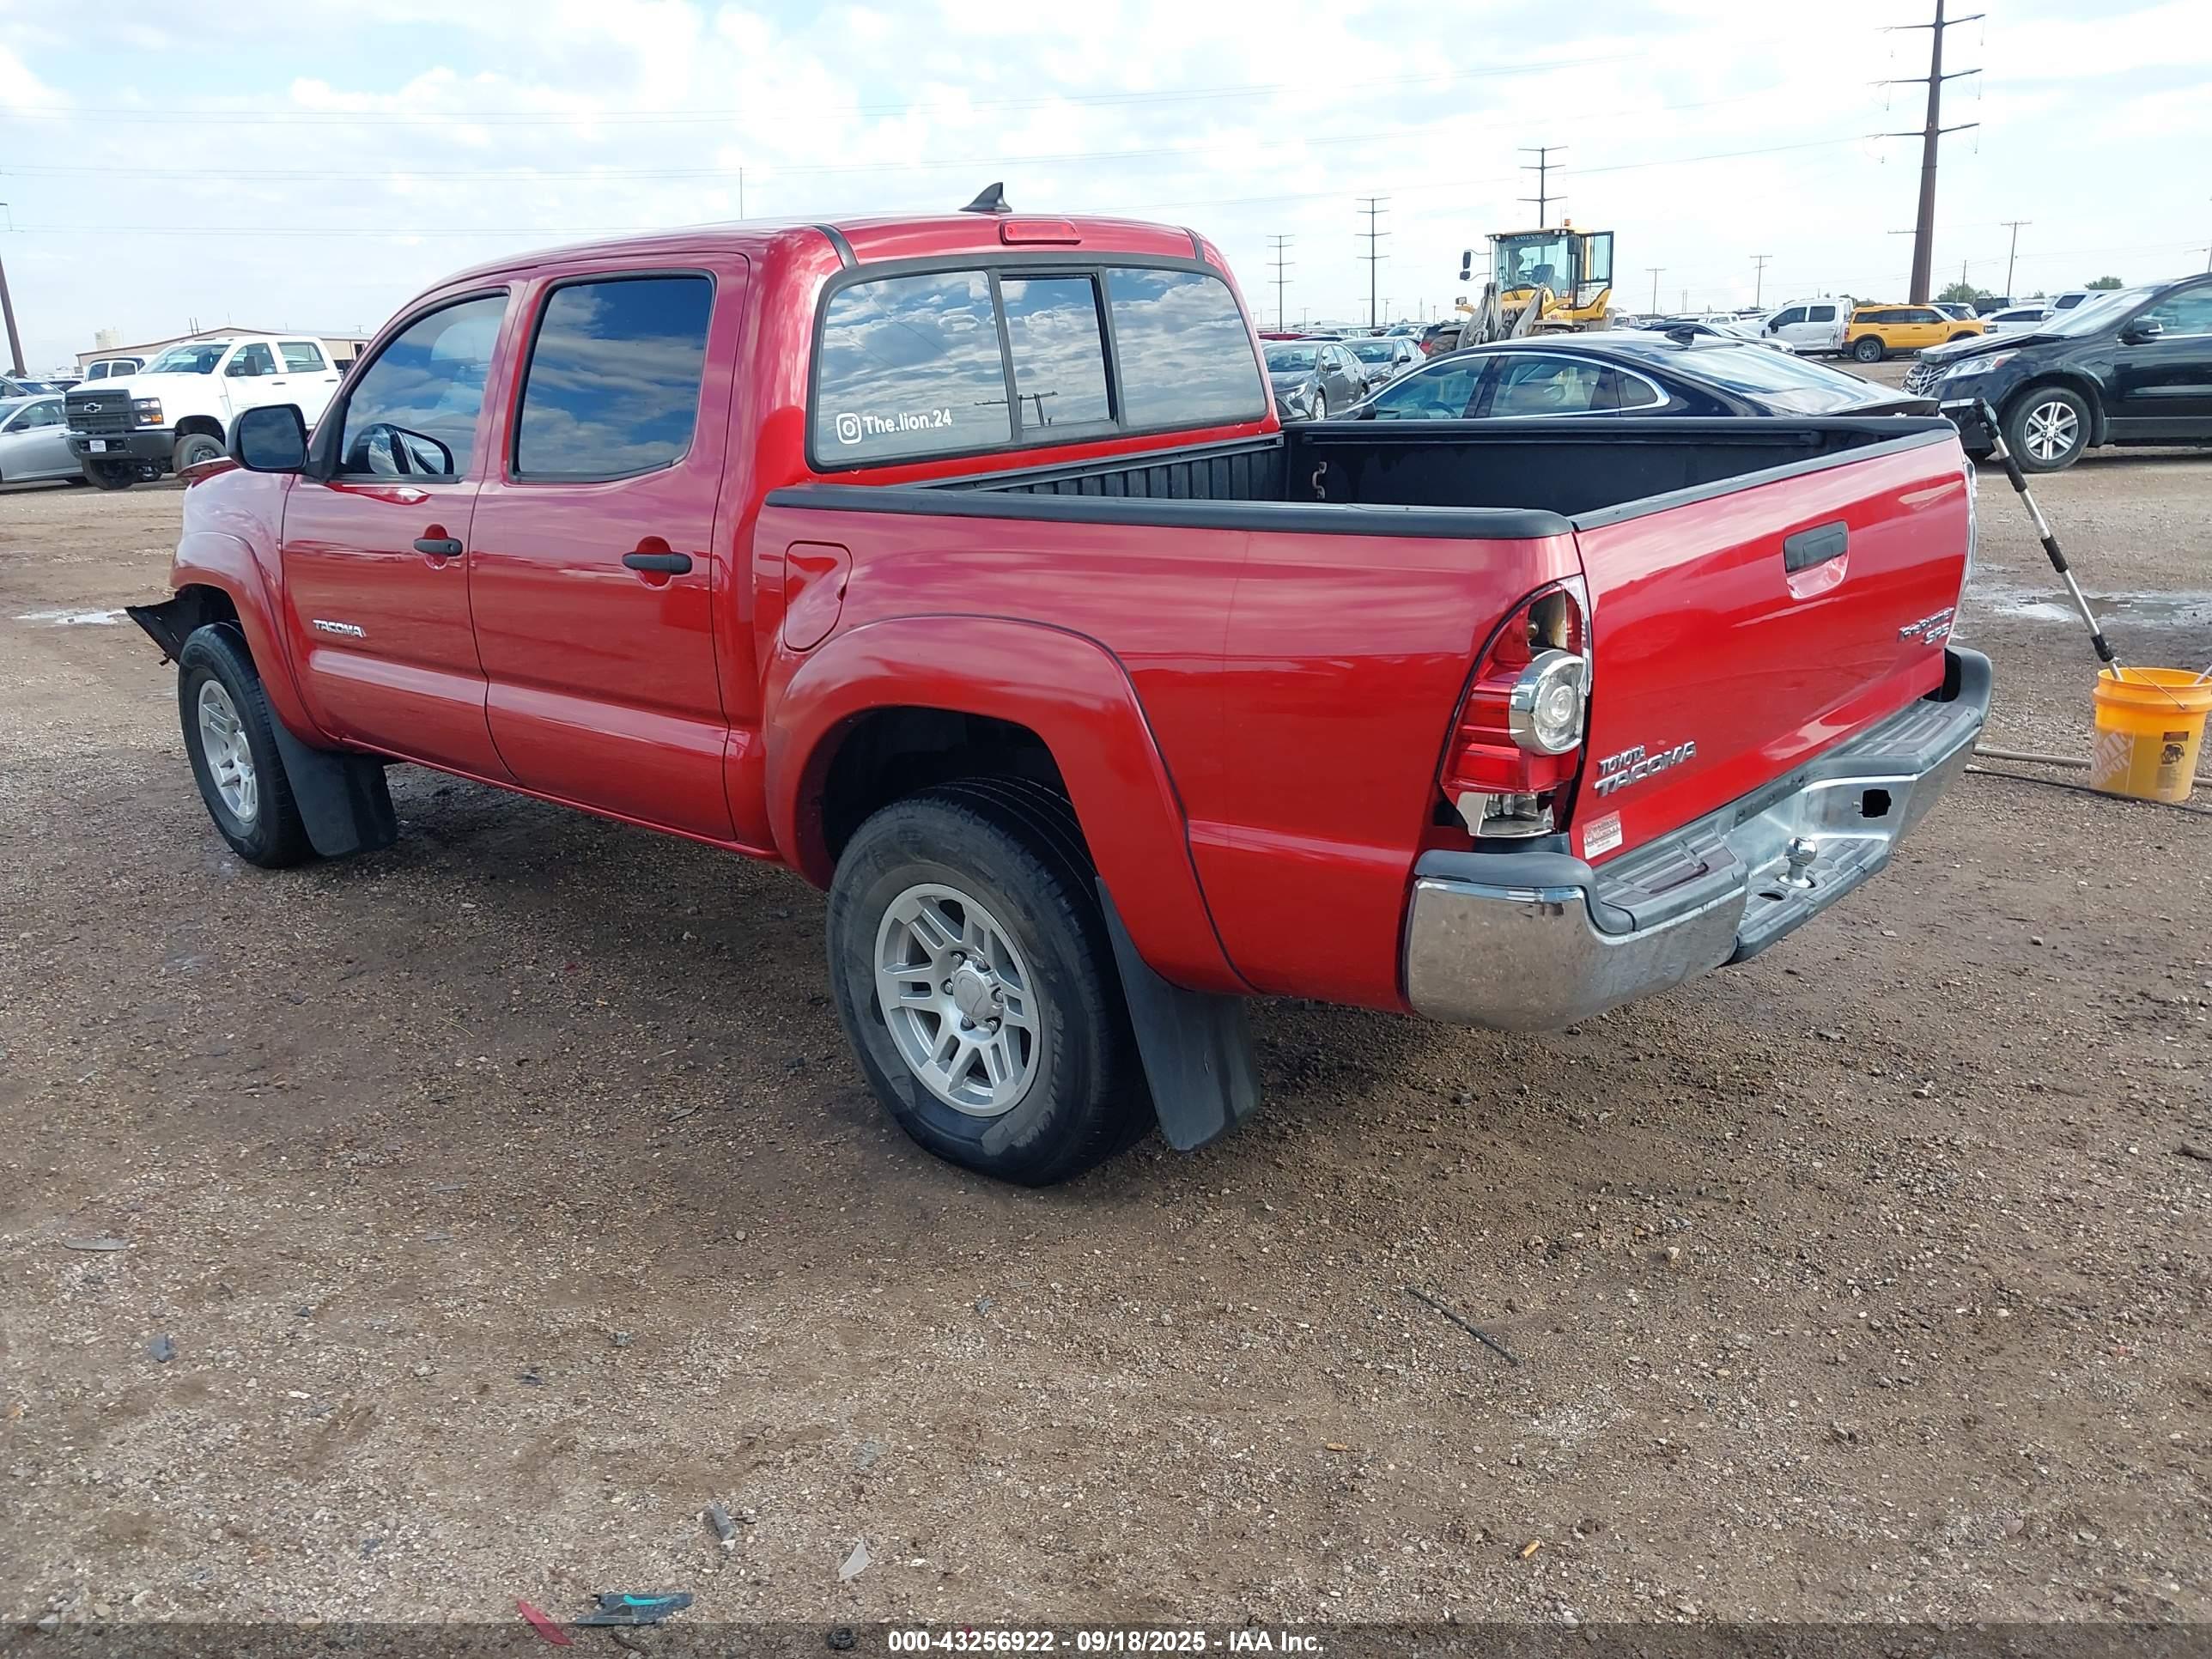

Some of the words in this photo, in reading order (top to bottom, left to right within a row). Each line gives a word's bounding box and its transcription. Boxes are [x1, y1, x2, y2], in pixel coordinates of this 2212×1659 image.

[862, 408, 952, 434] The.lion.24
[313, 619, 367, 638] TACOMA
[1594, 740, 1697, 797] TACOMA
[1598, 744, 1646, 776] TOYOTA
